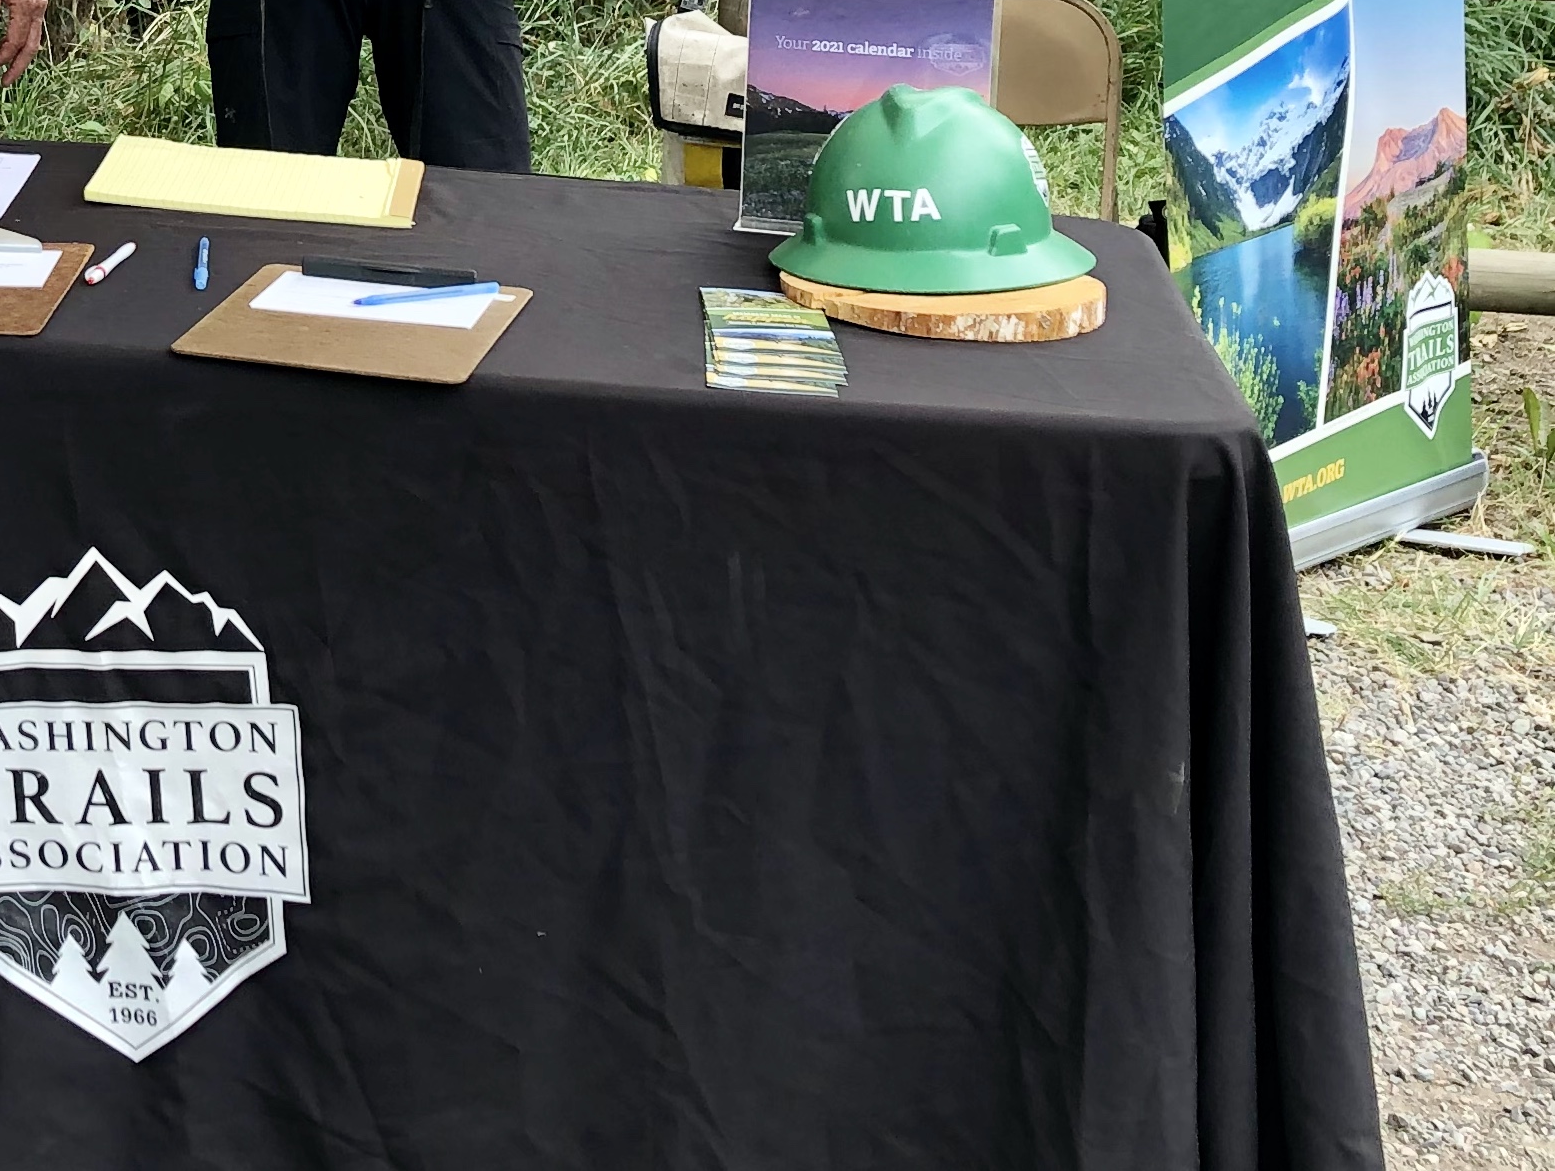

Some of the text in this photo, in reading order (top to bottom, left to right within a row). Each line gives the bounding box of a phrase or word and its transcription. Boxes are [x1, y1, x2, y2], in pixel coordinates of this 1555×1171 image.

[776, 35, 962, 61] Your 2021 calendar inside
[846, 188, 941, 223] WTA
[1282, 458, 1345, 504] WTA.ORG
[108, 980, 159, 1003] EST.
[109, 1006, 157, 1026] 1966
